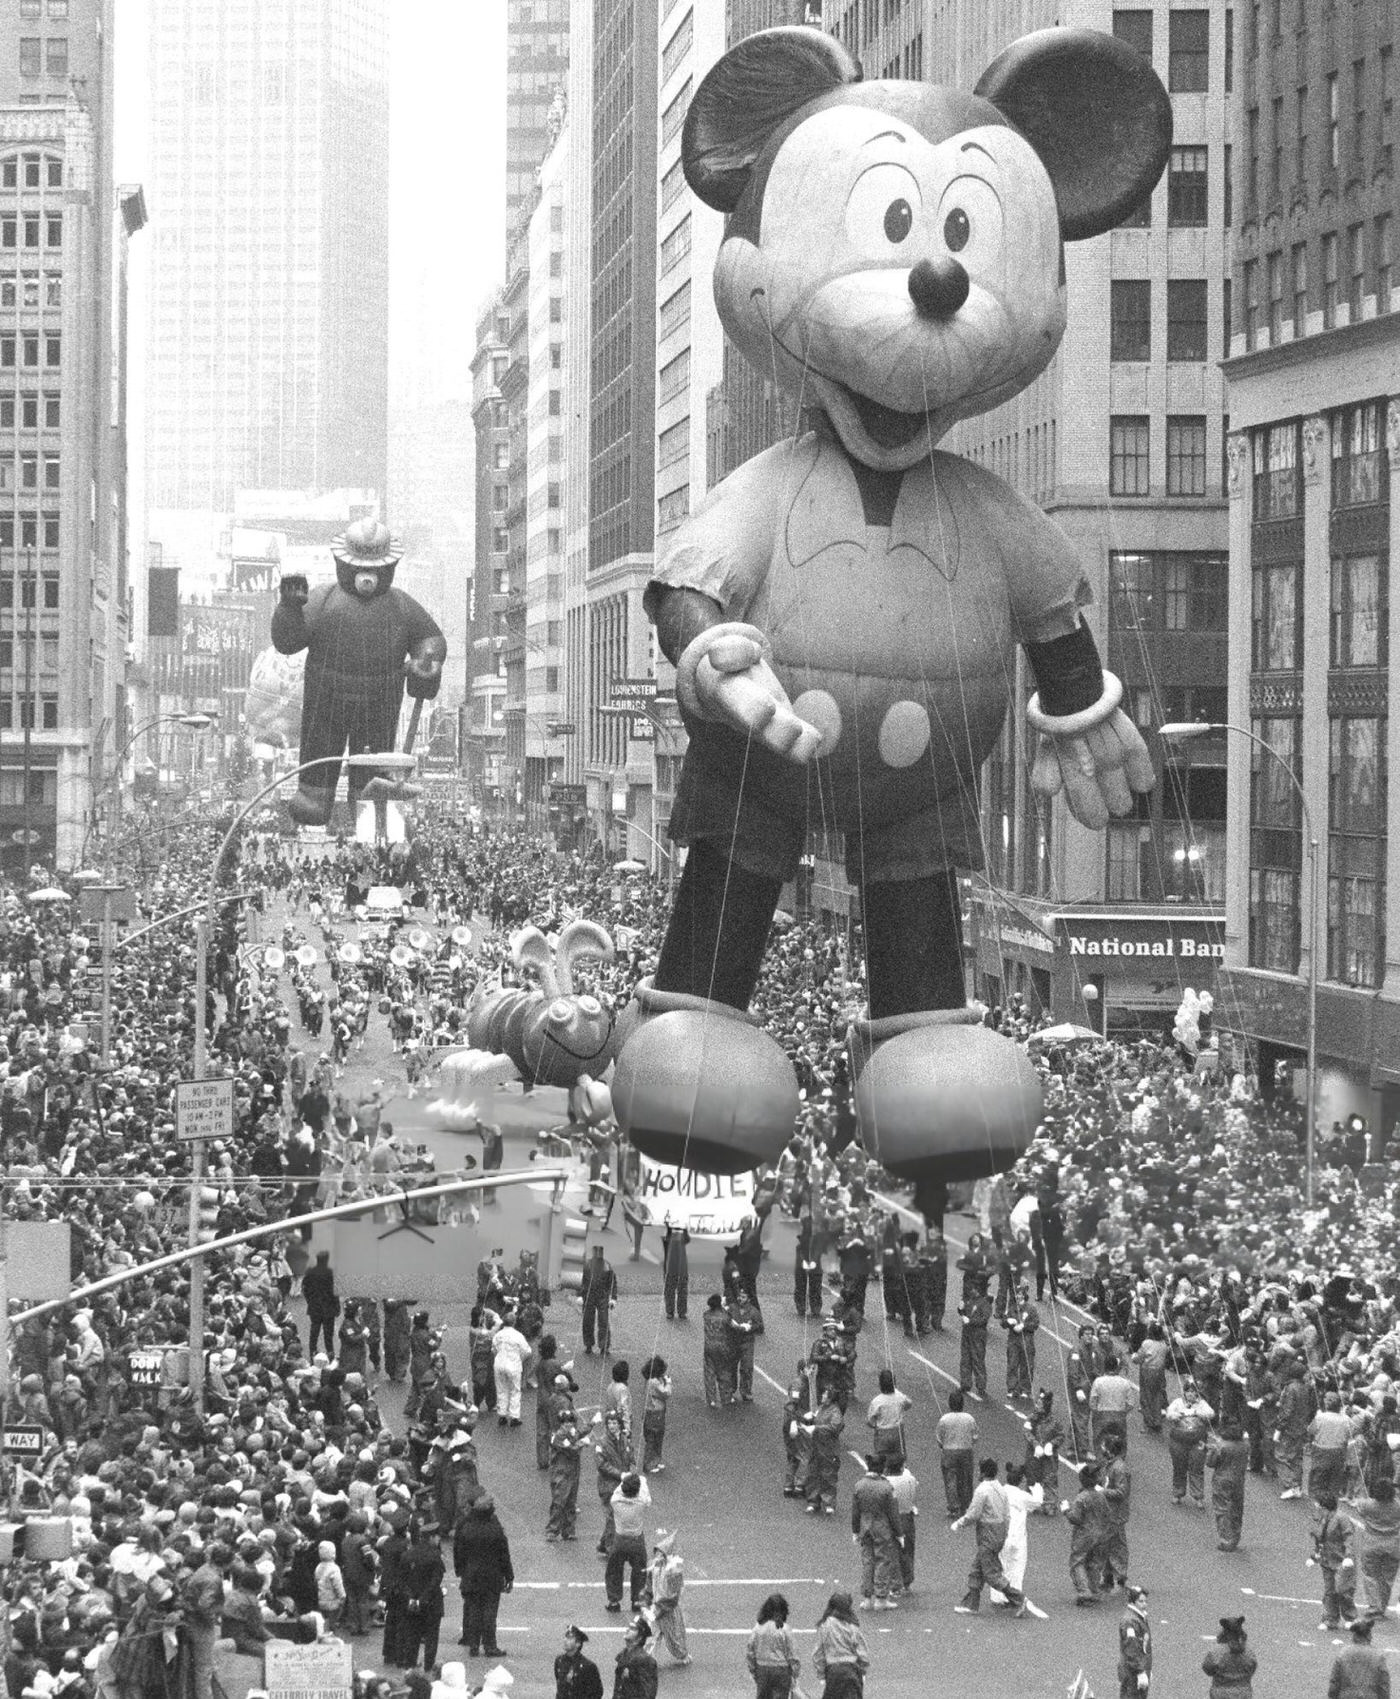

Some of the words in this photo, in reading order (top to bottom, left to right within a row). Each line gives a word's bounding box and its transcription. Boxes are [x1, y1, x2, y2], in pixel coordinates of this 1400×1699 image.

[1070, 937, 1174, 956] National
[1180, 939, 1226, 957] Ban
[180, 1098, 212, 1110] PASSENGER
[216, 1096, 230, 1107] CARS
[147, 1207, 156, 1220] W
[161, 1208, 176, 1222] 37
[132, 1372, 160, 1384] WALK
[11, 1434, 36, 1446] WAY
